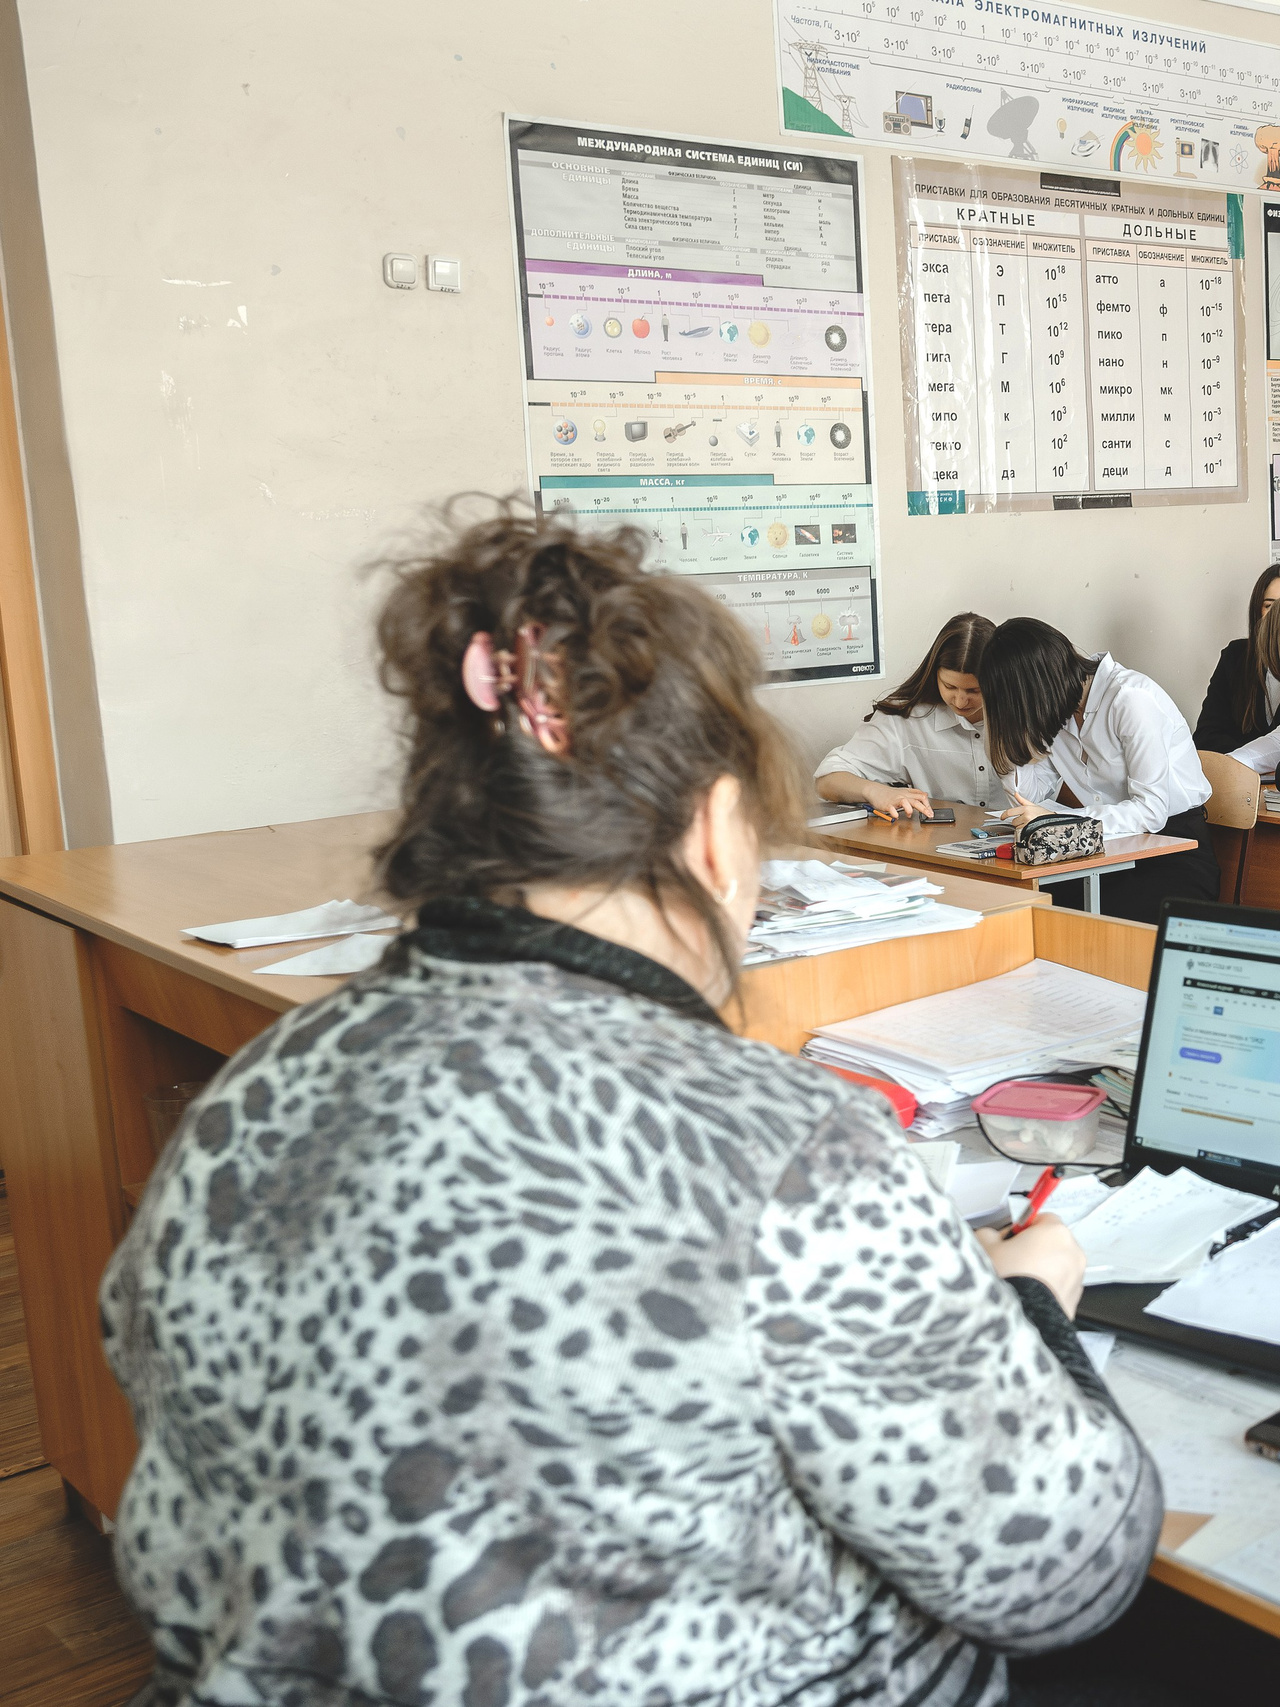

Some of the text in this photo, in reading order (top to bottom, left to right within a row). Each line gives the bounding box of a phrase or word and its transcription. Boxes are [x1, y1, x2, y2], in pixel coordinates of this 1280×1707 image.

[790, 15, 833, 31] Частота, Гц
[974, 0, 1207, 54] ЭЛЕКТРОМАГНИТНЫХ ИЗЛУЧЕНИЙ
[946, 83, 982, 94] РАДИОВОЛНЫ
[1067, 104, 1095, 115] ИЗЛУЧЕНИЕ
[1102, 106, 1126, 116] ВИДИМОЕ
[577, 136, 804, 173] МЕЖДУНАРОДНАЯ СИСТЕМА ЕДИНИЦ (СИ)
[551, 161, 611, 175] ОСНОВНЫЕ
[562, 173, 612, 185] ЕДИНИЦЫ
[621, 177, 639, 185] Длина
[623, 200, 680, 212] Количество вещества
[915, 183, 1225, 224] ПРИСТАВКИ ДЛЯ ОБРАЗОВАНИЯ ДЕСЯТИЧНЫХ КРАТНЫХ И ДОЛЬНЫХ ЕДИНИЦ
[623, 207, 712, 222] Термодинамическая температура
[956, 207, 1036, 227] КРАТНЫЕ
[638, 217, 680, 227] электрического
[531, 228, 615, 242] ДОПОЛНИТЕЛЬНЫЕ
[1123, 223, 1197, 241] ДОЛЬНЫЕ
[566, 241, 615, 253] ЕДИНИЦЫ
[918, 232, 1076, 254] ПРИСТАВК ОБОЗНАЧЕНИЕ МНОЖИТЕЛЬ
[626, 252, 652, 260] Телесный
[1092, 246, 1228, 266] ПРИСТАВКА ОБОЗНАЧЕНИЕ МНОЖИТЕЛЬ
[627, 268, 664, 280] ДЛИНА,
[922, 262, 949, 274] экса
[996, 265, 1004, 277] Э
[1095, 274, 1119, 285] атто
[1159, 277, 1166, 288] а
[924, 292, 951, 304] пета
[997, 294, 1005, 306] П
[1096, 301, 1131, 315] фемто
[1159, 304, 1168, 317] ф
[925, 322, 952, 335] тера
[999, 323, 1006, 335] Т
[1097, 330, 1123, 340] пико
[1161, 332, 1168, 342] п
[1001, 352, 1008, 364] Г
[1099, 357, 1125, 368] нано
[1162, 359, 1168, 369] н
[744, 377, 776, 386] ВРЕМЯ,
[927, 381, 955, 393] мега
[1001, 381, 1010, 393] М
[1099, 385, 1133, 397] микро
[1160, 386, 1173, 396] мк
[1004, 412, 1010, 421] к
[1101, 412, 1136, 422] милли
[1164, 413, 1171, 422] м
[1005, 441, 1011, 450] г
[1101, 439, 1132, 450] санти
[1165, 439, 1171, 448] с
[932, 470, 959, 482] дека
[1001, 469, 1016, 481] да
[1102, 466, 1129, 477] деци
[1165, 466, 1172, 477] д
[640, 478, 673, 487] МАССА,
[738, 573, 801, 583] ТЕМПЕРАТУРА,
[751, 591, 762, 599] 500
